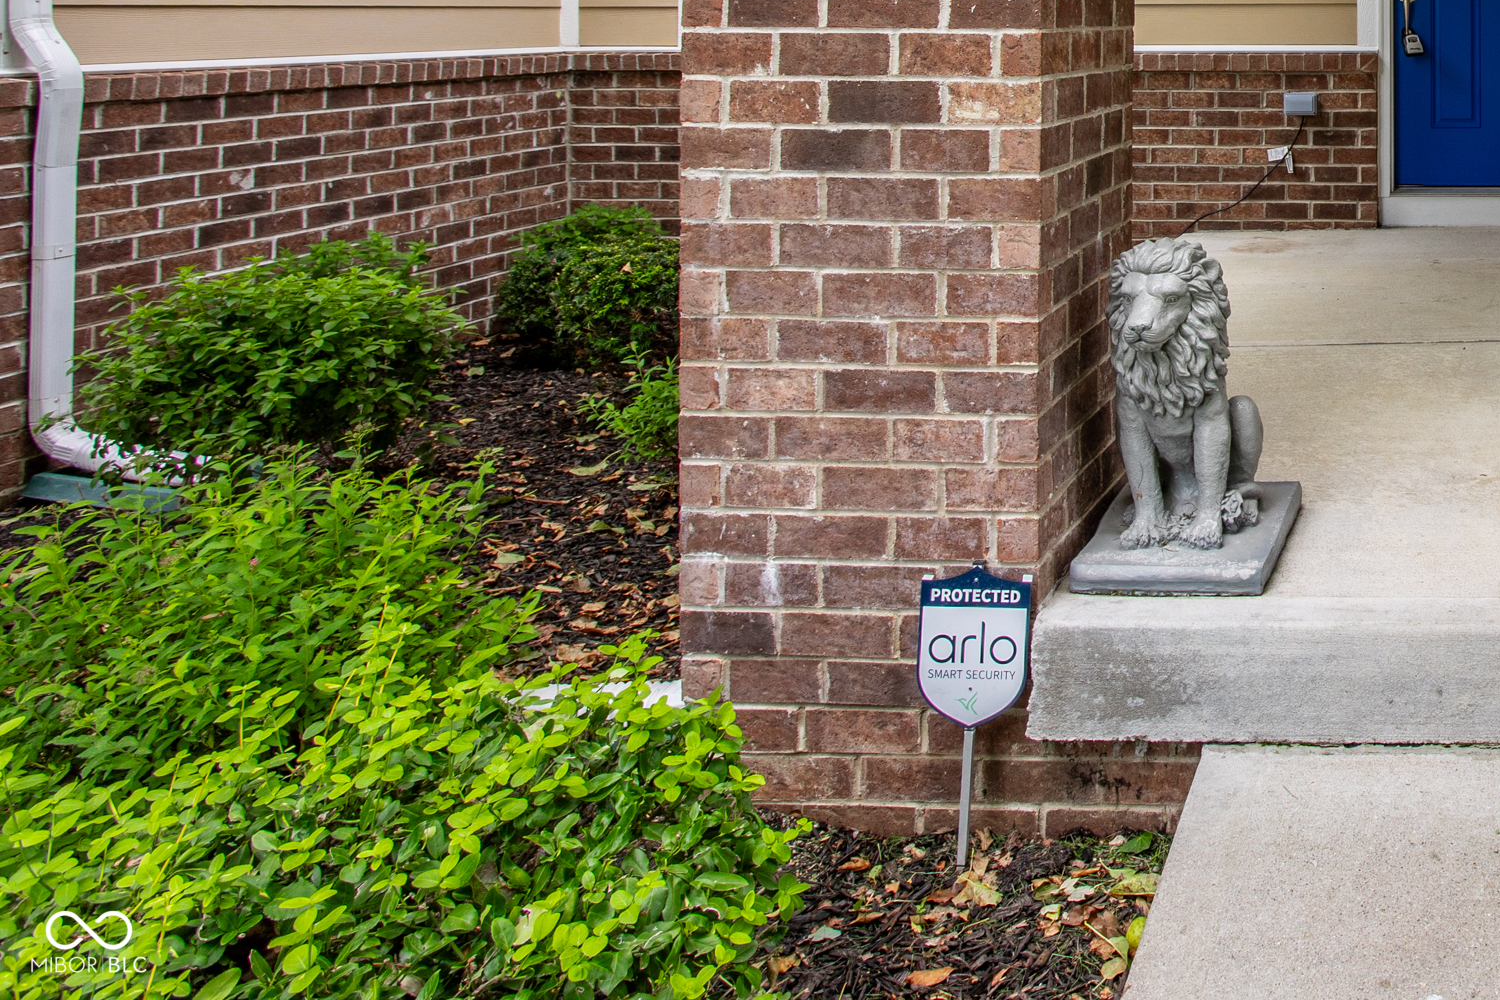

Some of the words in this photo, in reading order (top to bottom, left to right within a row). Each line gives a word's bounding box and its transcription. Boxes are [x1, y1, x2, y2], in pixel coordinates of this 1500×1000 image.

[930, 588, 1021, 604] PROTECTED
[928, 621, 1018, 665] arlo
[928, 669, 963, 680] SMART
[966, 669, 1017, 681] SECURITY
